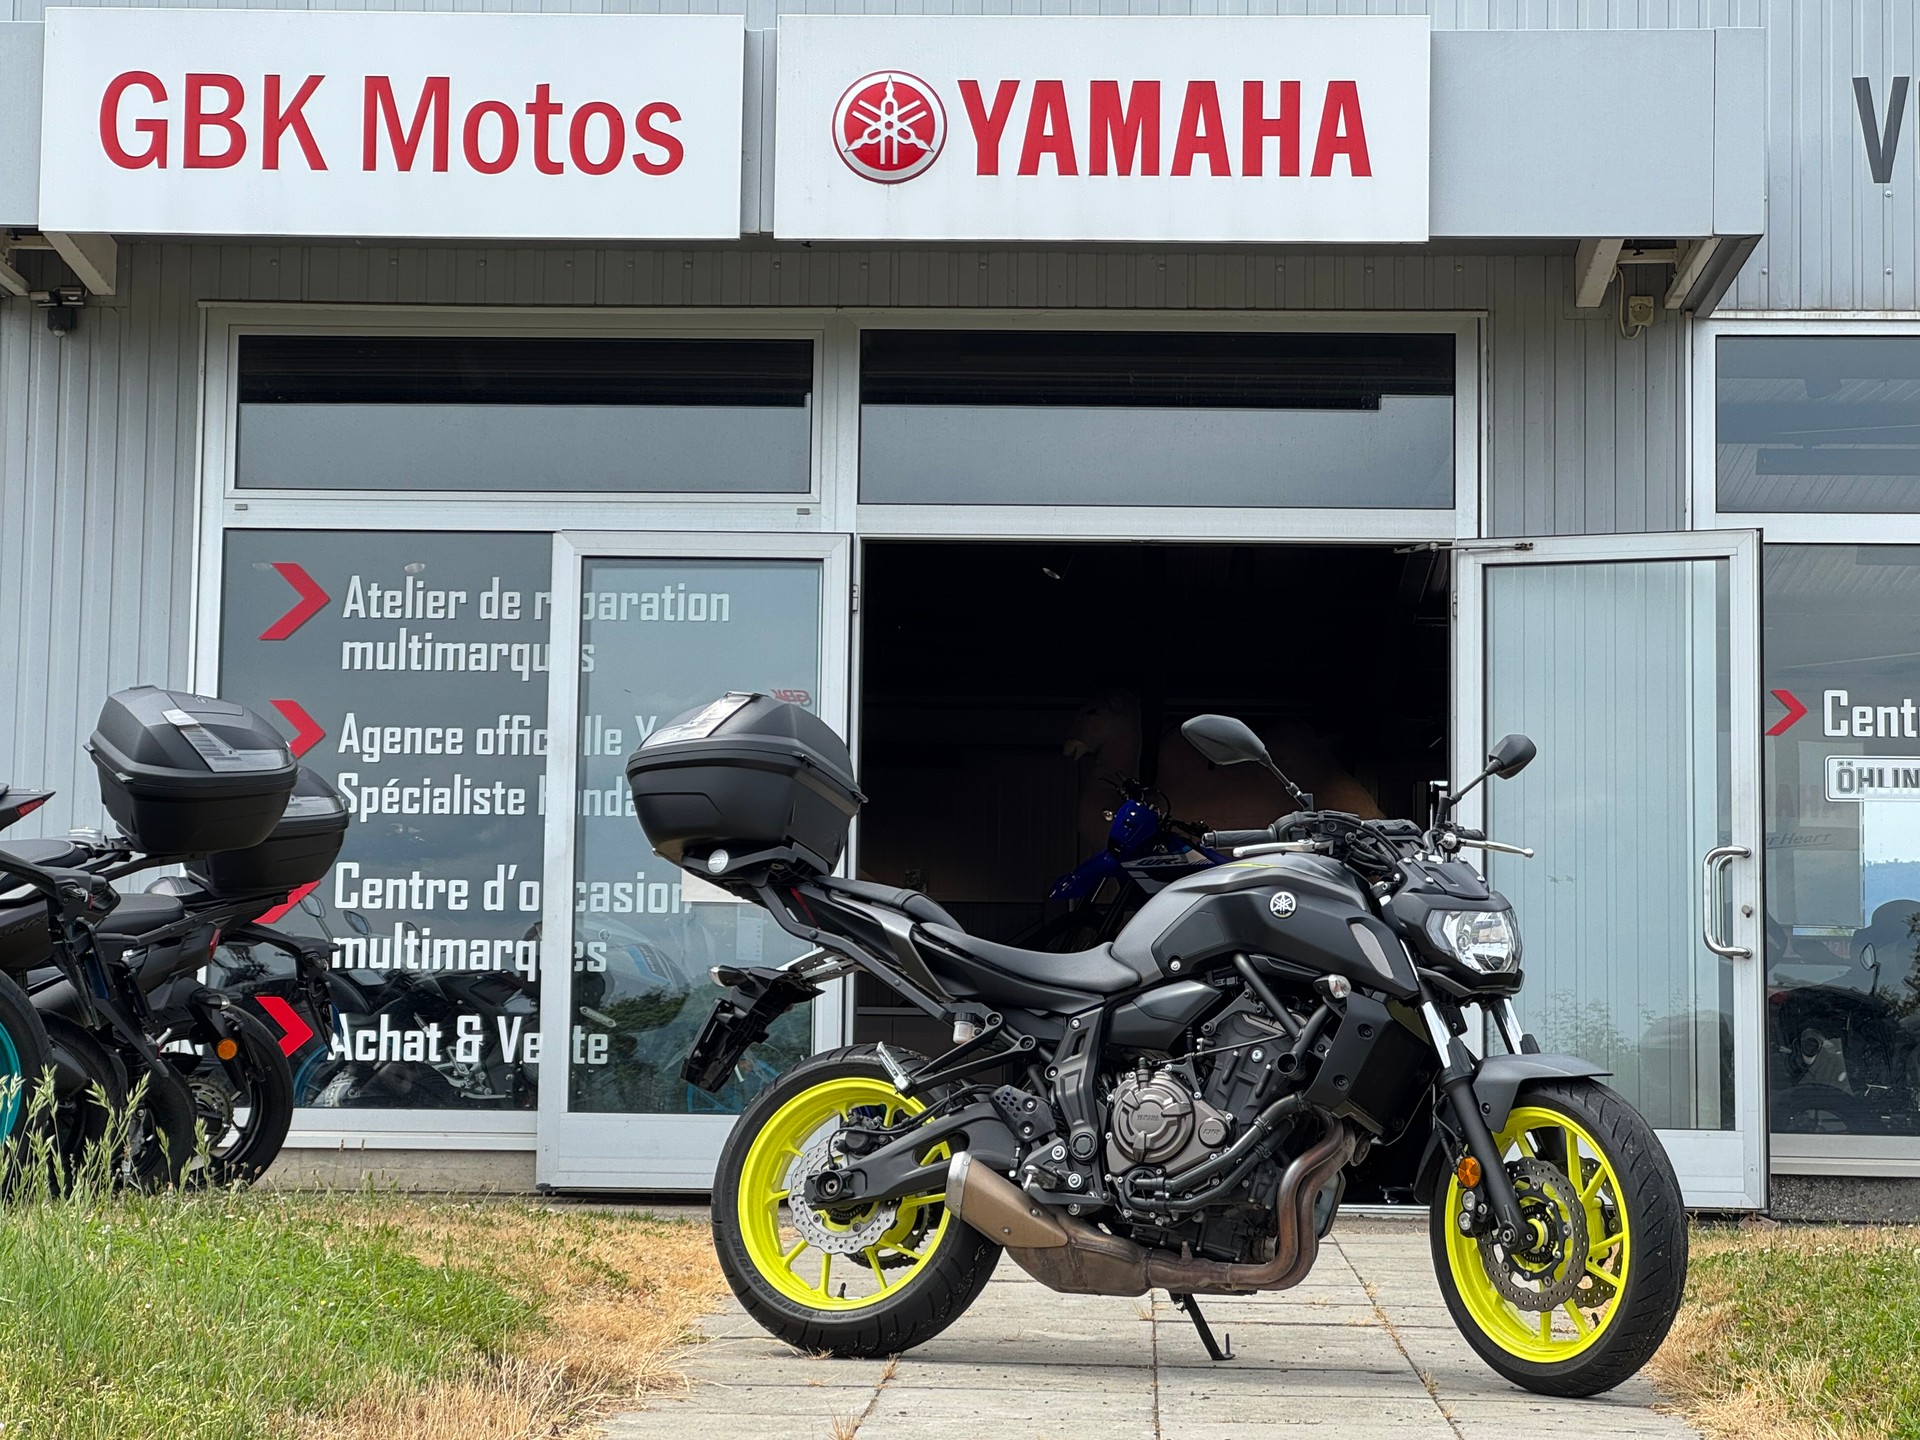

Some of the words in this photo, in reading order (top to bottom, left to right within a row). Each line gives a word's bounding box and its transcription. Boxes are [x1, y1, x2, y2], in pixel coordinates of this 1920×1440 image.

[99, 70, 329, 172] GBK
[362, 75, 685, 177] Motos
[957, 79, 1373, 178] YAMAHA
[1852, 76, 1920, 185] V
[342, 575, 467, 620] Atelier
[479, 576, 522, 621] de
[534, 582, 731, 622] rparation
[341, 627, 595, 681] multimarqus
[338, 712, 463, 762] Agence
[476, 714, 622, 756] officlle
[1823, 689, 1920, 738] Cent
[337, 772, 525, 823] Spécialiste
[334, 861, 468, 911] Centre
[327, 1013, 442, 1062] Achat
[456, 1015, 483, 1064] &
[497, 1016, 609, 1065] Vete
